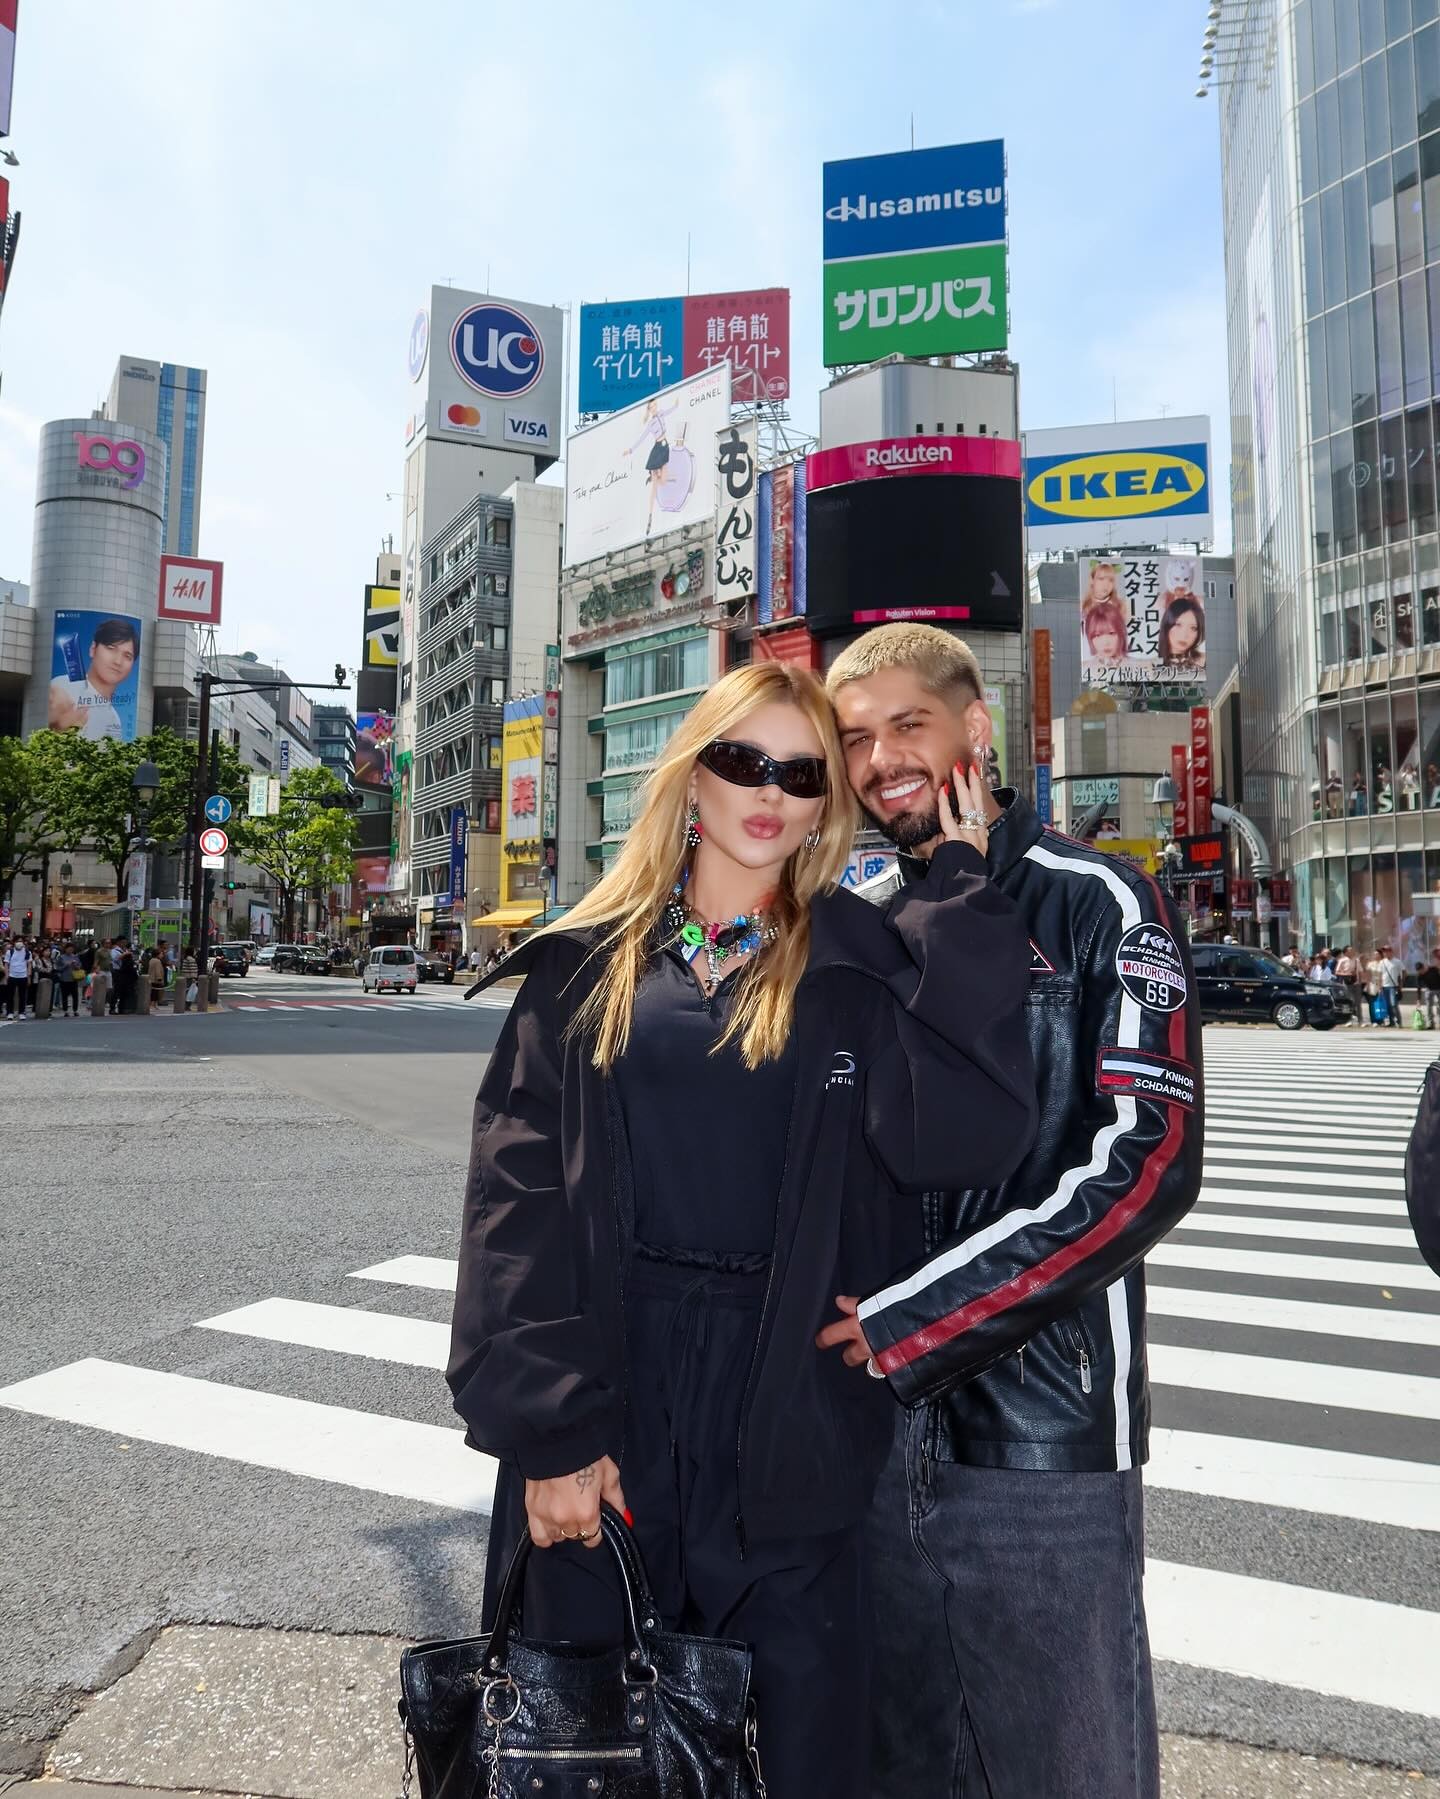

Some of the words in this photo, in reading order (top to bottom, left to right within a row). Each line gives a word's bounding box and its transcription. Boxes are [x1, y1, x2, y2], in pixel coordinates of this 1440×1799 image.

[834, 276, 996, 331] サロンパス
[602, 321, 662, 353] 龍角散
[706, 313, 769, 344] 龍角散
[593, 350, 674, 381] ダイレクト
[690, 388, 721, 407] CHANEL
[509, 418, 548, 438] VISA
[73, 431, 146, 489] 109
[865, 444, 953, 468] Rakuten
[715, 428, 754, 593] もんじゃ
[172, 578, 206, 601] H&M
[885, 608, 914, 618] Rakuten
[914, 607, 936, 617] Vision
[1123, 560, 1144, 654] スターダム
[1142, 560, 1161, 655] 女子プロレス
[77, 695, 92, 706] Are
[94, 694, 109, 705] You
[1193, 716, 1210, 785] カラオケ
[1074, 793, 1119, 803] クリニック
[1085, 781, 1119, 792] れいわ
[1121, 946, 1182, 969] SCHDARROW
[1142, 956, 1173, 970] KNHOR
[1123, 961, 1185, 989] MOTORCYCLES
[1145, 981, 1169, 1005] 69
[1134, 1078, 1194, 1103] SCHDARROW
[1165, 1070, 1194, 1089] KNHOR
